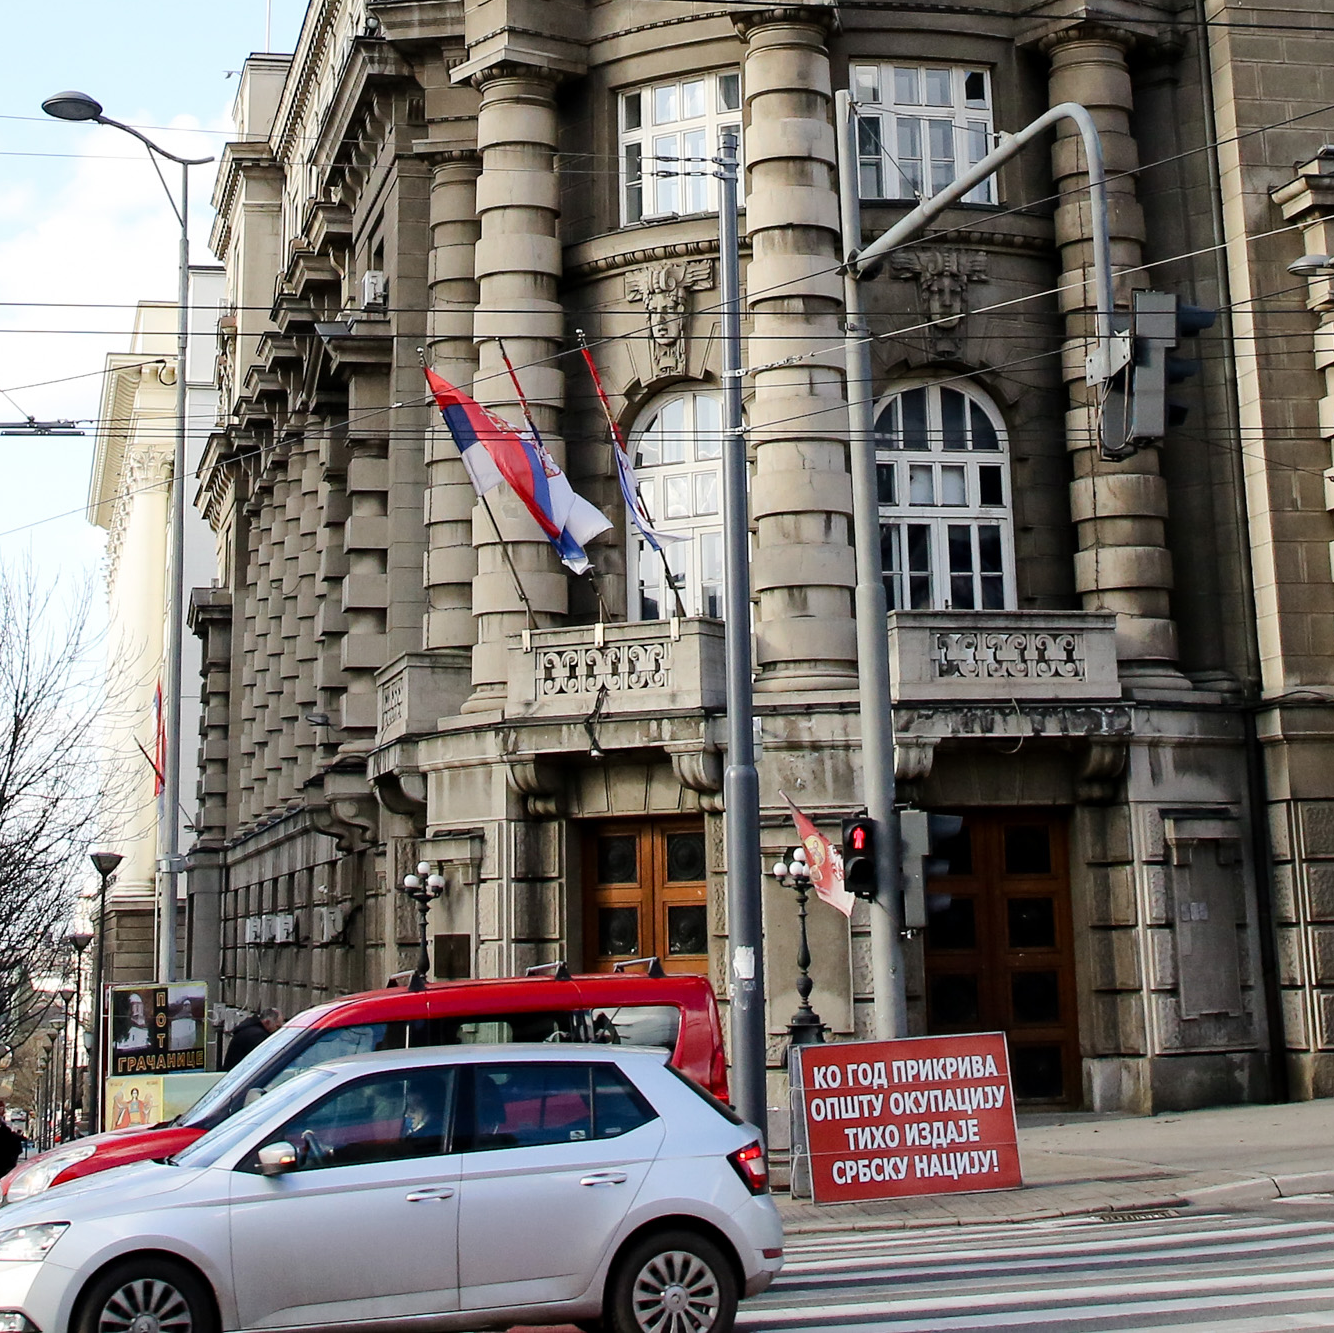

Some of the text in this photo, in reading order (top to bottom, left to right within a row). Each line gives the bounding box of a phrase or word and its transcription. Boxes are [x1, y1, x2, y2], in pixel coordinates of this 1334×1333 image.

[118, 1050, 204, 1073] ГРАЧАНИЦЕ
[813, 1054, 998, 1089] КО ГОД ПРИКРИВА
[810, 1085, 1006, 1122] ОПШТУ ОКУПАЦИЈУ
[844, 1118, 980, 1151] ТИХО ИЗДАЈЕ
[832, 1149, 999, 1185] СРБСКУ НАЦИЈУ!
